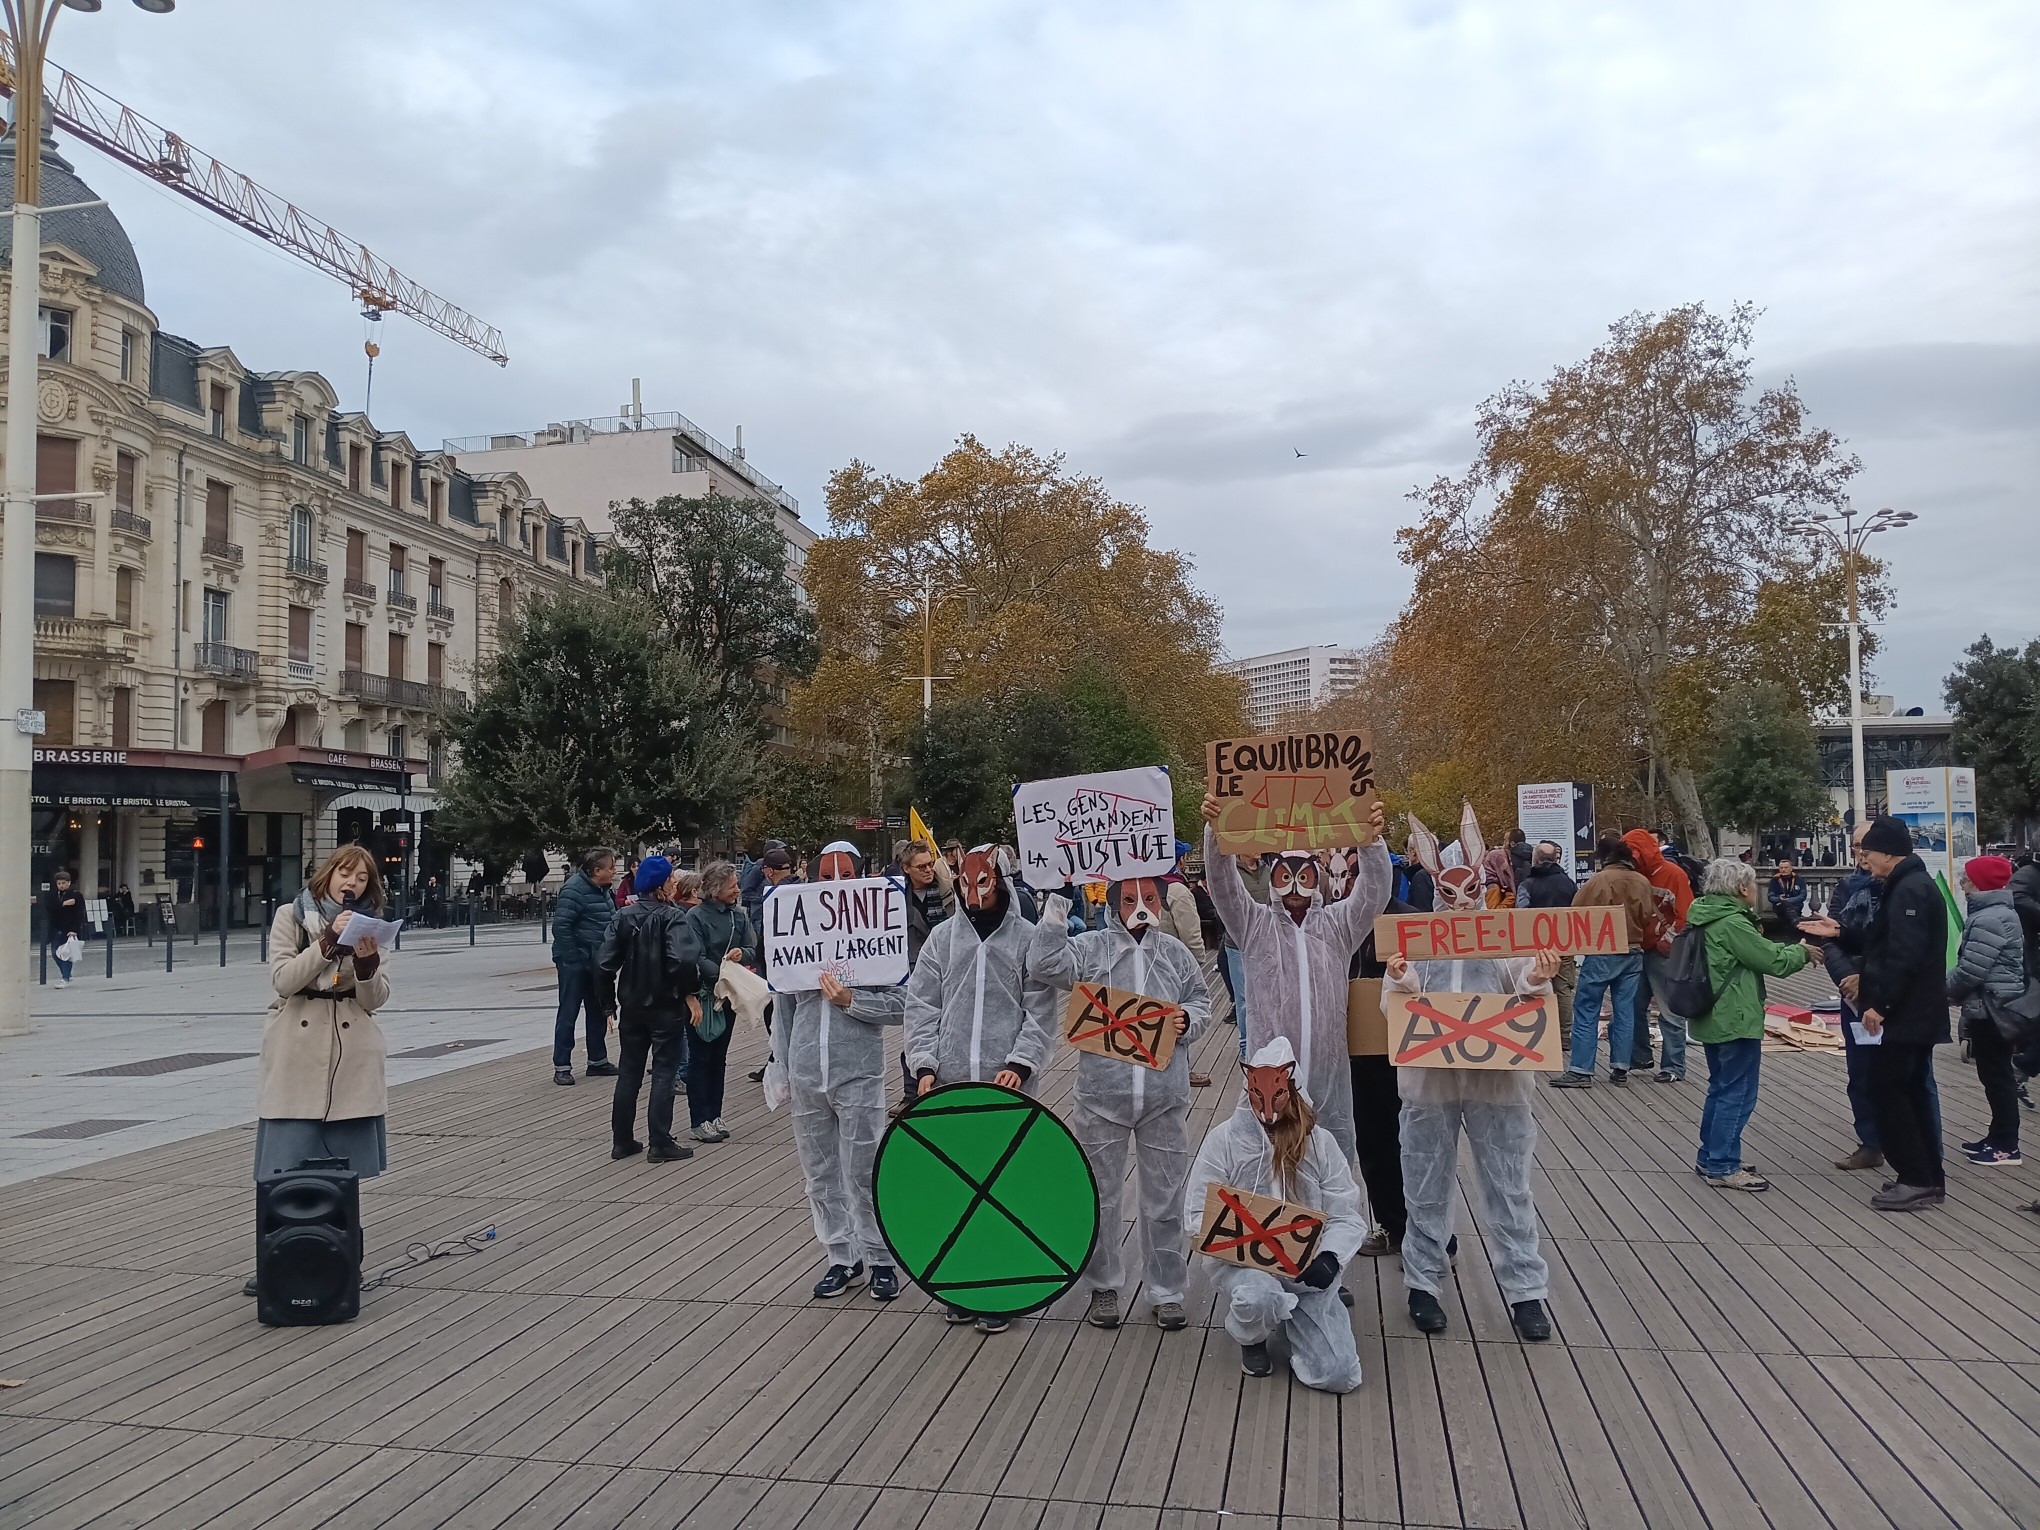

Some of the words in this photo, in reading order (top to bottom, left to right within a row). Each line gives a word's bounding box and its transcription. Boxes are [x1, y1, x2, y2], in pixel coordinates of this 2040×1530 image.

[33, 750, 127, 764] BRASSERIE
[328, 753, 347, 765] CAFE
[370, 757, 407, 771] BRASSER
[1215, 732, 1375, 797] EQUILIBRONS
[59, 796, 70, 804] LE
[72, 797, 107, 805] BRISTOL
[112, 797, 122, 806] LE
[123, 798, 153, 806] BRISTOL
[165, 799, 191, 807] BRISTOL
[1215, 774, 1243, 797] LE
[1022, 801, 1056, 824] LES
[1067, 791, 1109, 816] GENS
[1057, 806, 1168, 838] DEMANDENT
[1217, 797, 1367, 849] CLIMAT
[31, 845, 52, 854] TEL
[1028, 850, 1049, 868] LA
[773, 894, 809, 937] LA
[772, 941, 824, 968] AVANT
[835, 935, 904, 961] L'ARGENT
[1067, 986, 1166, 1063] A69
[1396, 995, 1547, 1065] A69
[1200, 1193, 1323, 1273] A69
